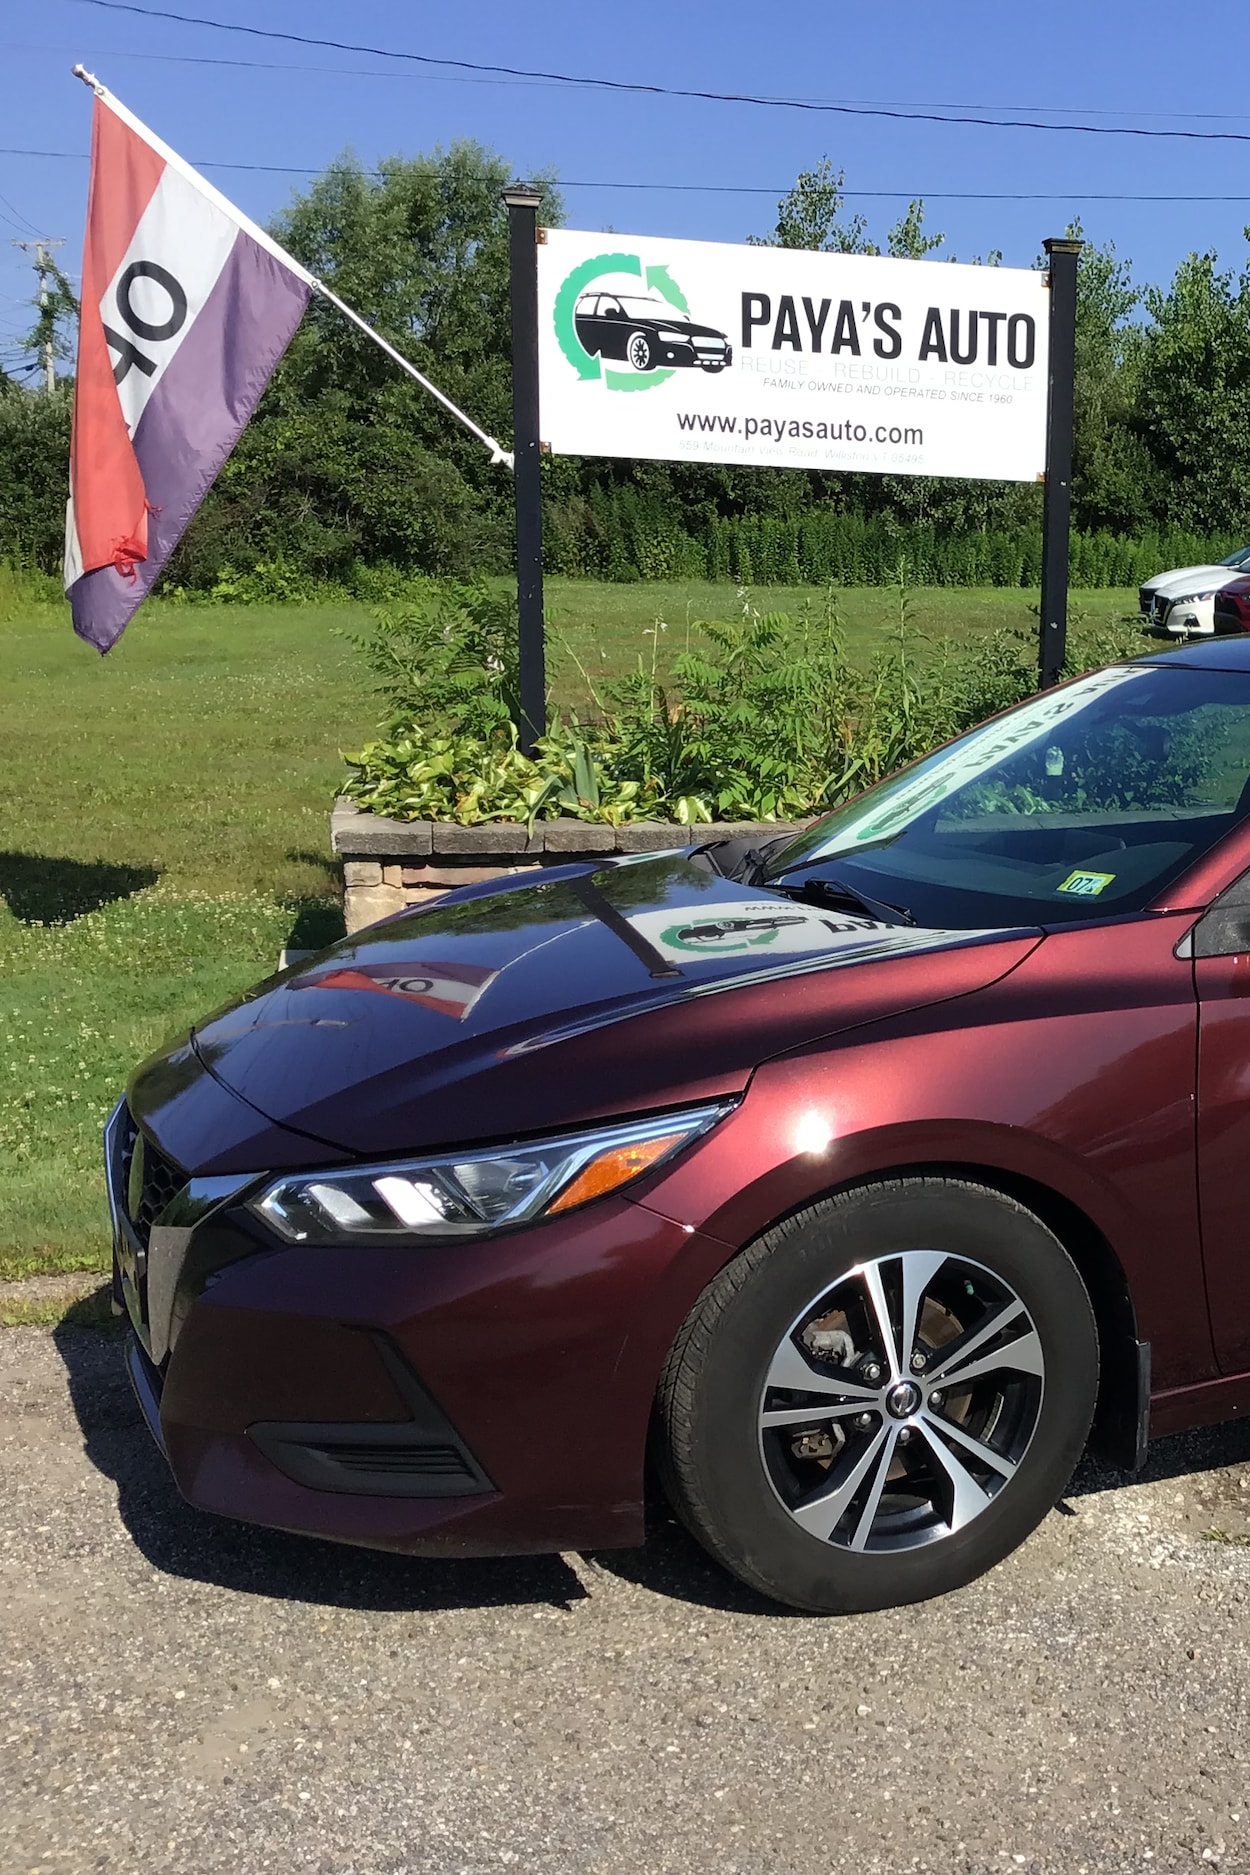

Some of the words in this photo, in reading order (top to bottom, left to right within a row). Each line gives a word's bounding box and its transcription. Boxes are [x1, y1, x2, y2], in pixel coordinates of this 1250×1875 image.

[741, 291, 902, 360] PAYA'S
[918, 306, 1036, 370] AUTO
[741, 355, 809, 376] REUSE
[834, 362, 921, 384] REBUILD
[944, 370, 1033, 391] RECYCLE
[763, 377, 804, 390] FAMILY
[808, 381, 853, 393] OWNED
[856, 384, 881, 396] AND
[884, 386, 947, 400] OPERATED
[950, 391, 984, 402] SINCE
[989, 394, 1013, 404] 1960
[677, 412, 923, 445] www.payasauto.com
[1067, 877, 1093, 891] 07
